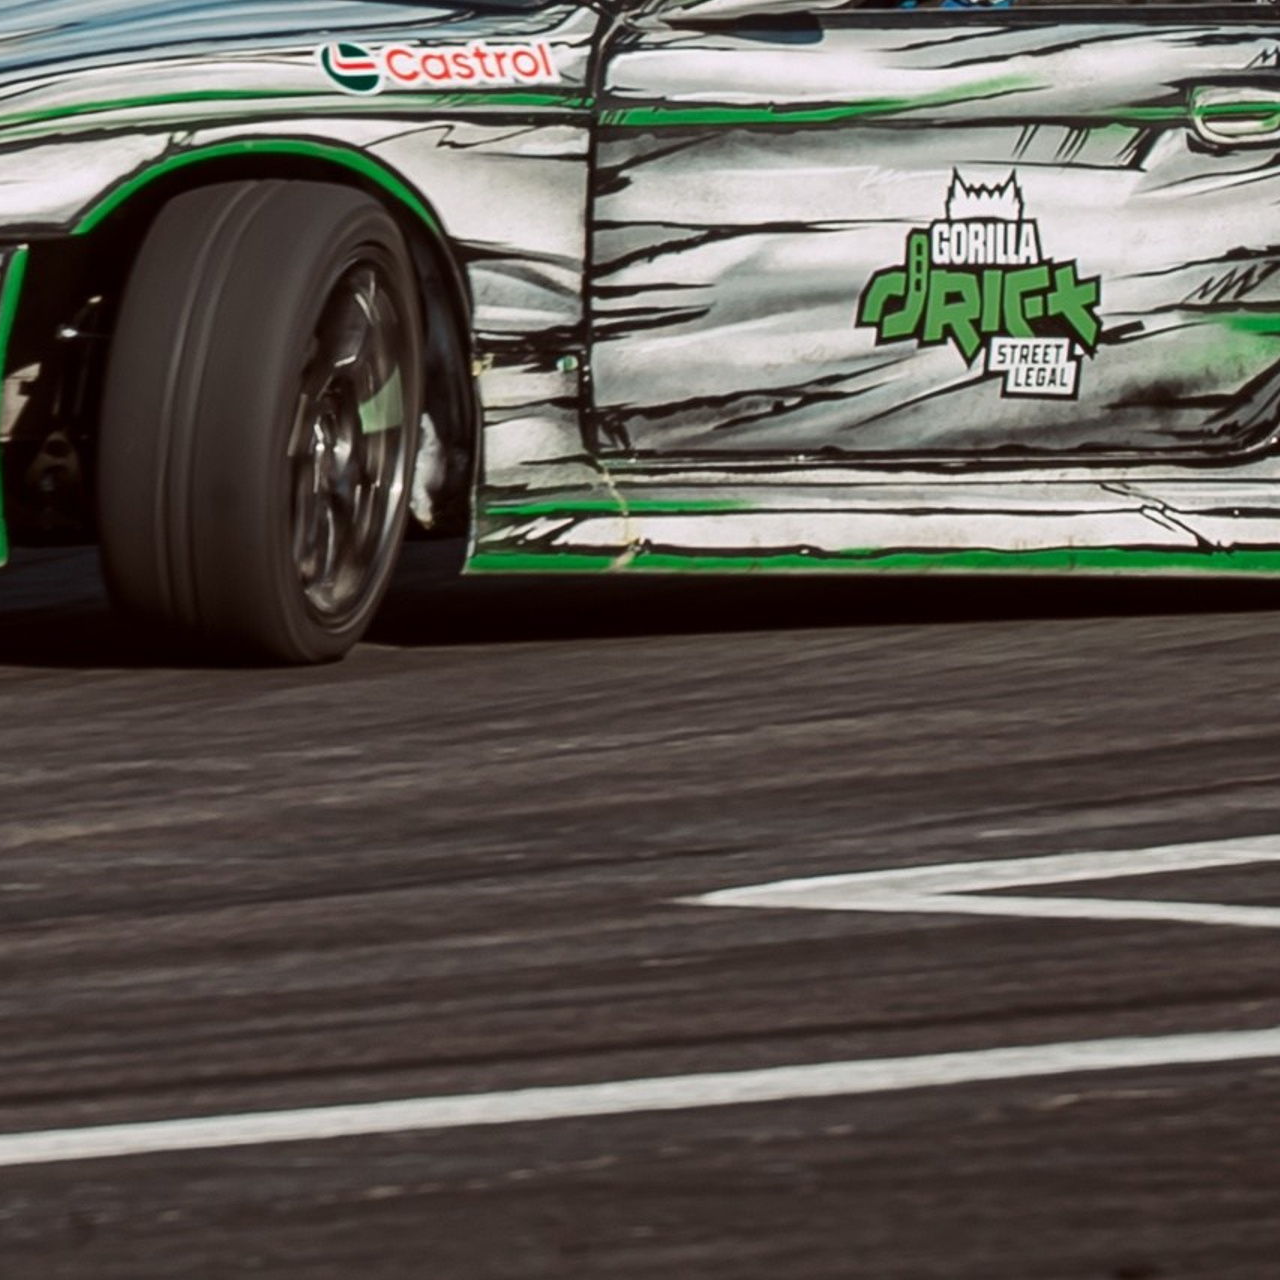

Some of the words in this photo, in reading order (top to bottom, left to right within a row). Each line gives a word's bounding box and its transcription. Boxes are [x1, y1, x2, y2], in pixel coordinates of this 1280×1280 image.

[385, 44, 552, 82] Castrol
[931, 222, 1040, 265] GORILLA
[997, 343, 1064, 365] STREET
[1014, 365, 1069, 388] LEGAL
